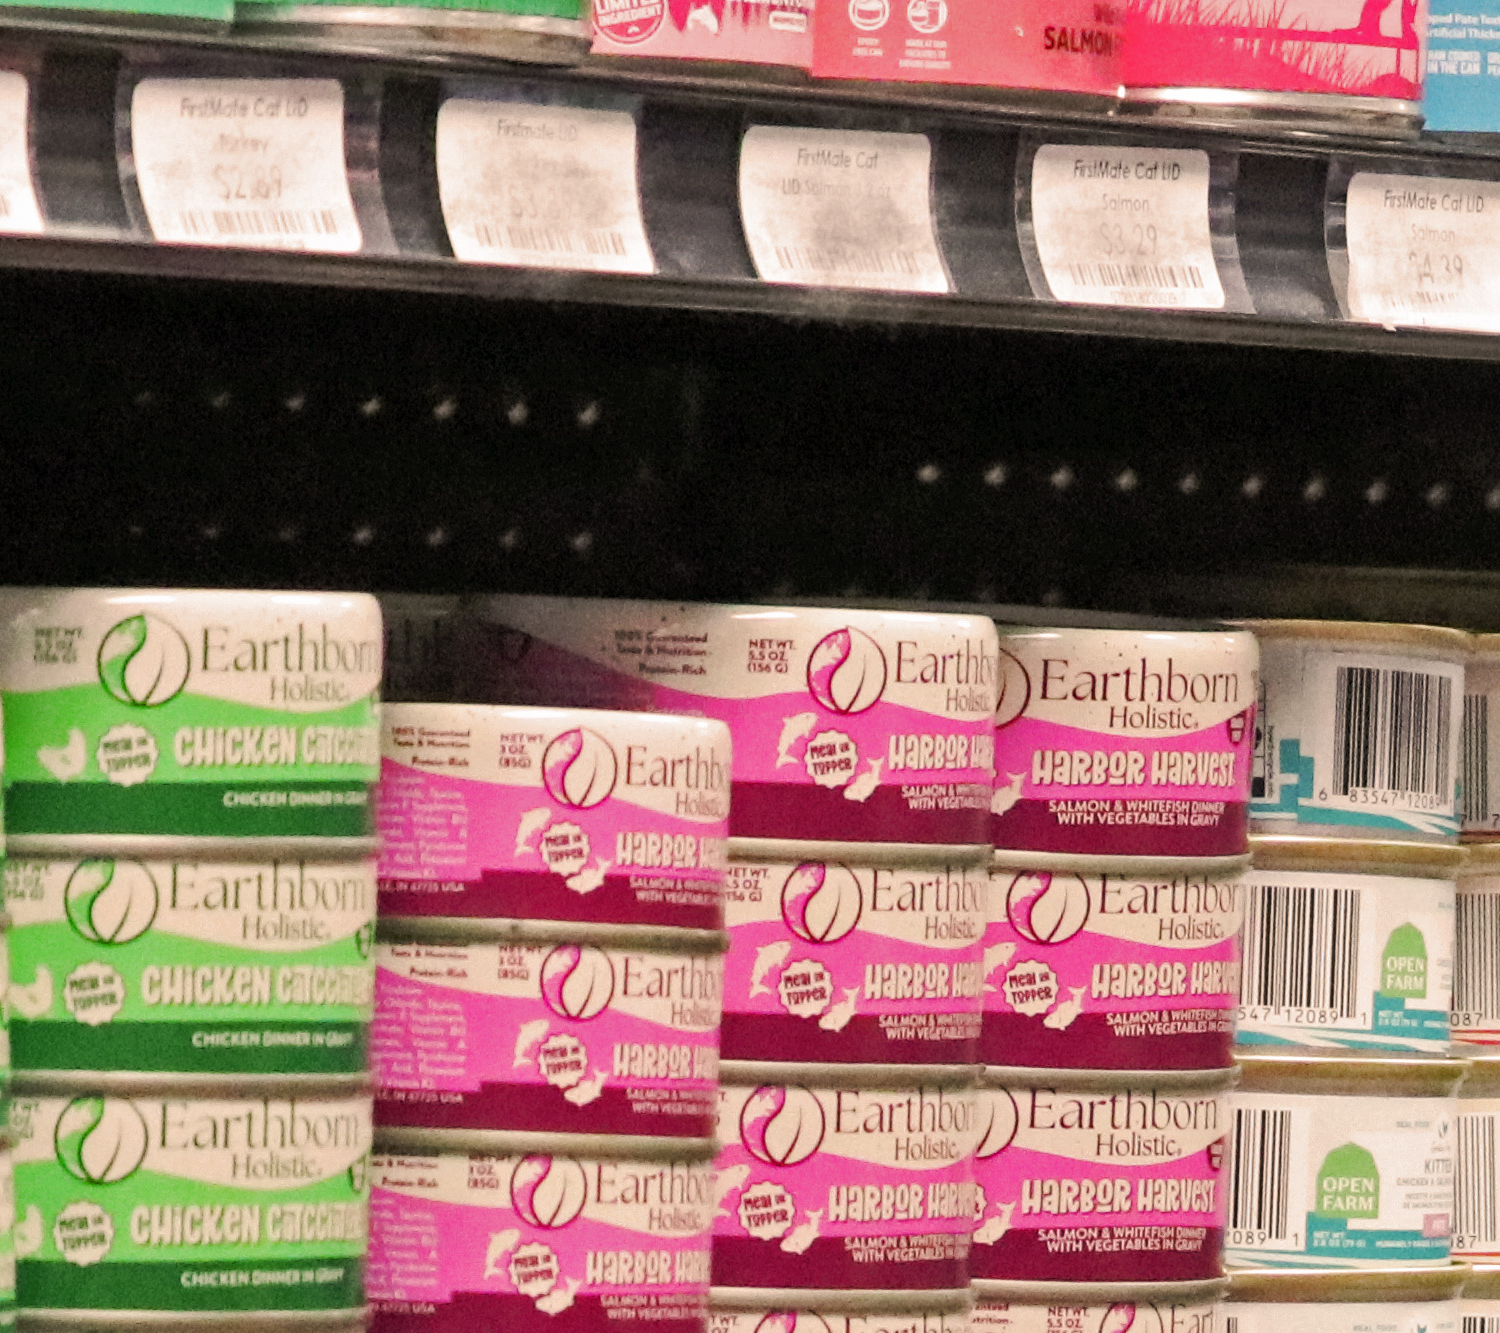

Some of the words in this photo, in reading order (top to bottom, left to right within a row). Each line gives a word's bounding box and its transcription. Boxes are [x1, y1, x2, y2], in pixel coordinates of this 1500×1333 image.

[1074, 160, 1131, 180] FirstMate
[1135, 162, 1158, 180] Cat
[1102, 195, 1149, 212] Salmon
[1099, 225, 1158, 256] $3.29
[1039, 658, 1240, 703] Earthborn
[1109, 705, 1195, 731] Holistic
[1349, 789, 1398, 807] 83547
[1049, 800, 1104, 815] SALMON
[1109, 801, 1122, 815] &
[1127, 800, 1186, 816] WHITEFISH
[1056, 811, 1095, 826] WITH
[1099, 811, 1174, 826] VEGETABLES
[241, 914, 331, 941] Holistic
[192, 1031, 255, 1048] CHICKEN
